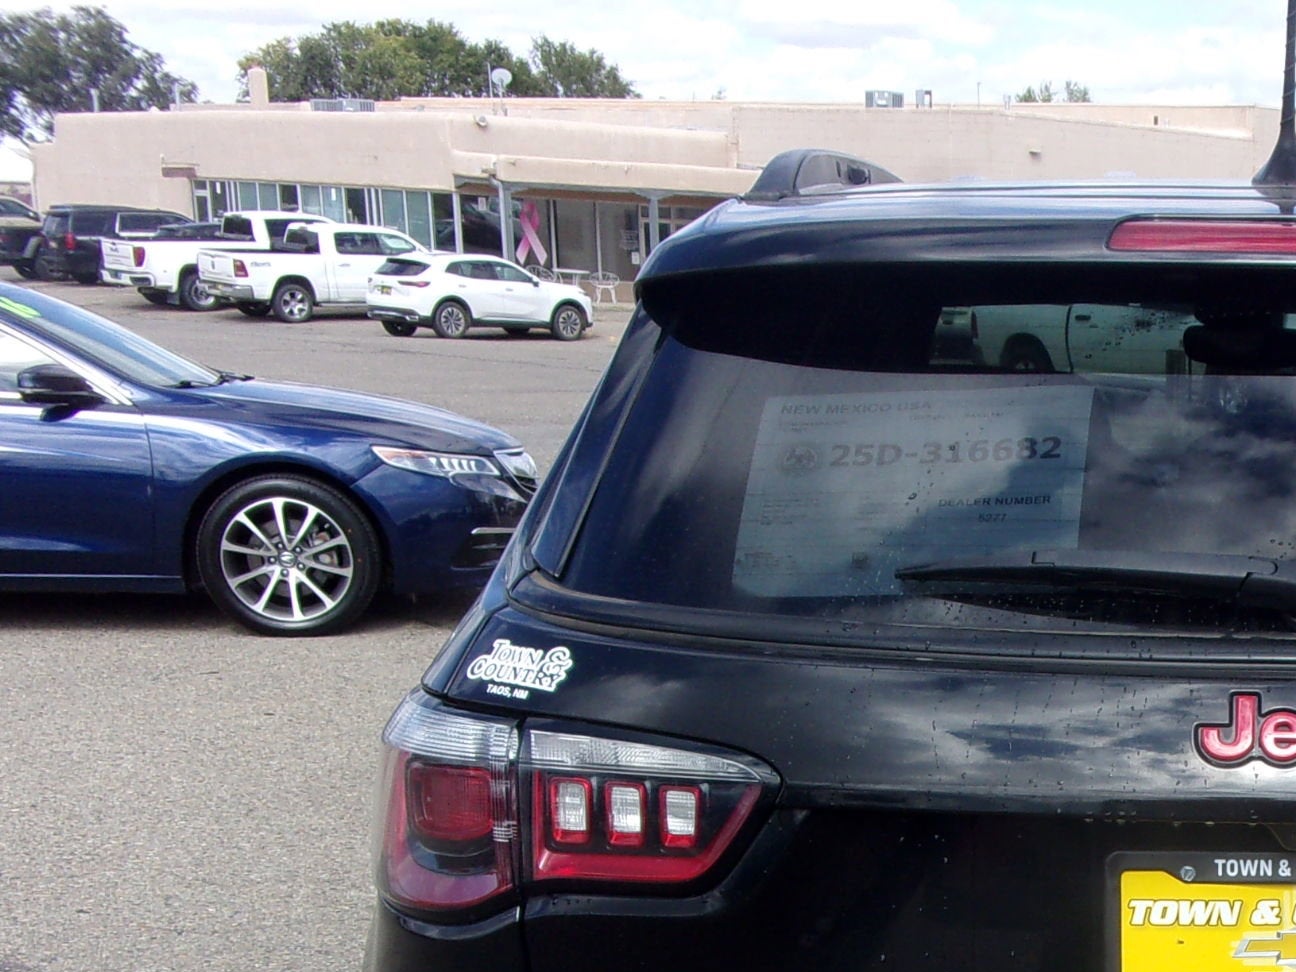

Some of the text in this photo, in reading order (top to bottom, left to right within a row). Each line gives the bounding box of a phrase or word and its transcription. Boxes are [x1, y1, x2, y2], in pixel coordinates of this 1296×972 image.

[781, 400, 932, 415] NEW MEXICO USA
[830, 436, 1062, 467] 25D-316682
[938, 495, 1051, 507] DEALER NUMBER
[468, 656, 563, 689] COUNTRY
[486, 683, 529, 699] TAOS, NM
[1214, 859, 1274, 877] TOWN
[1278, 859, 1292, 877] &
[1128, 899, 1242, 926] TOWN
[1250, 900, 1281, 926] &
